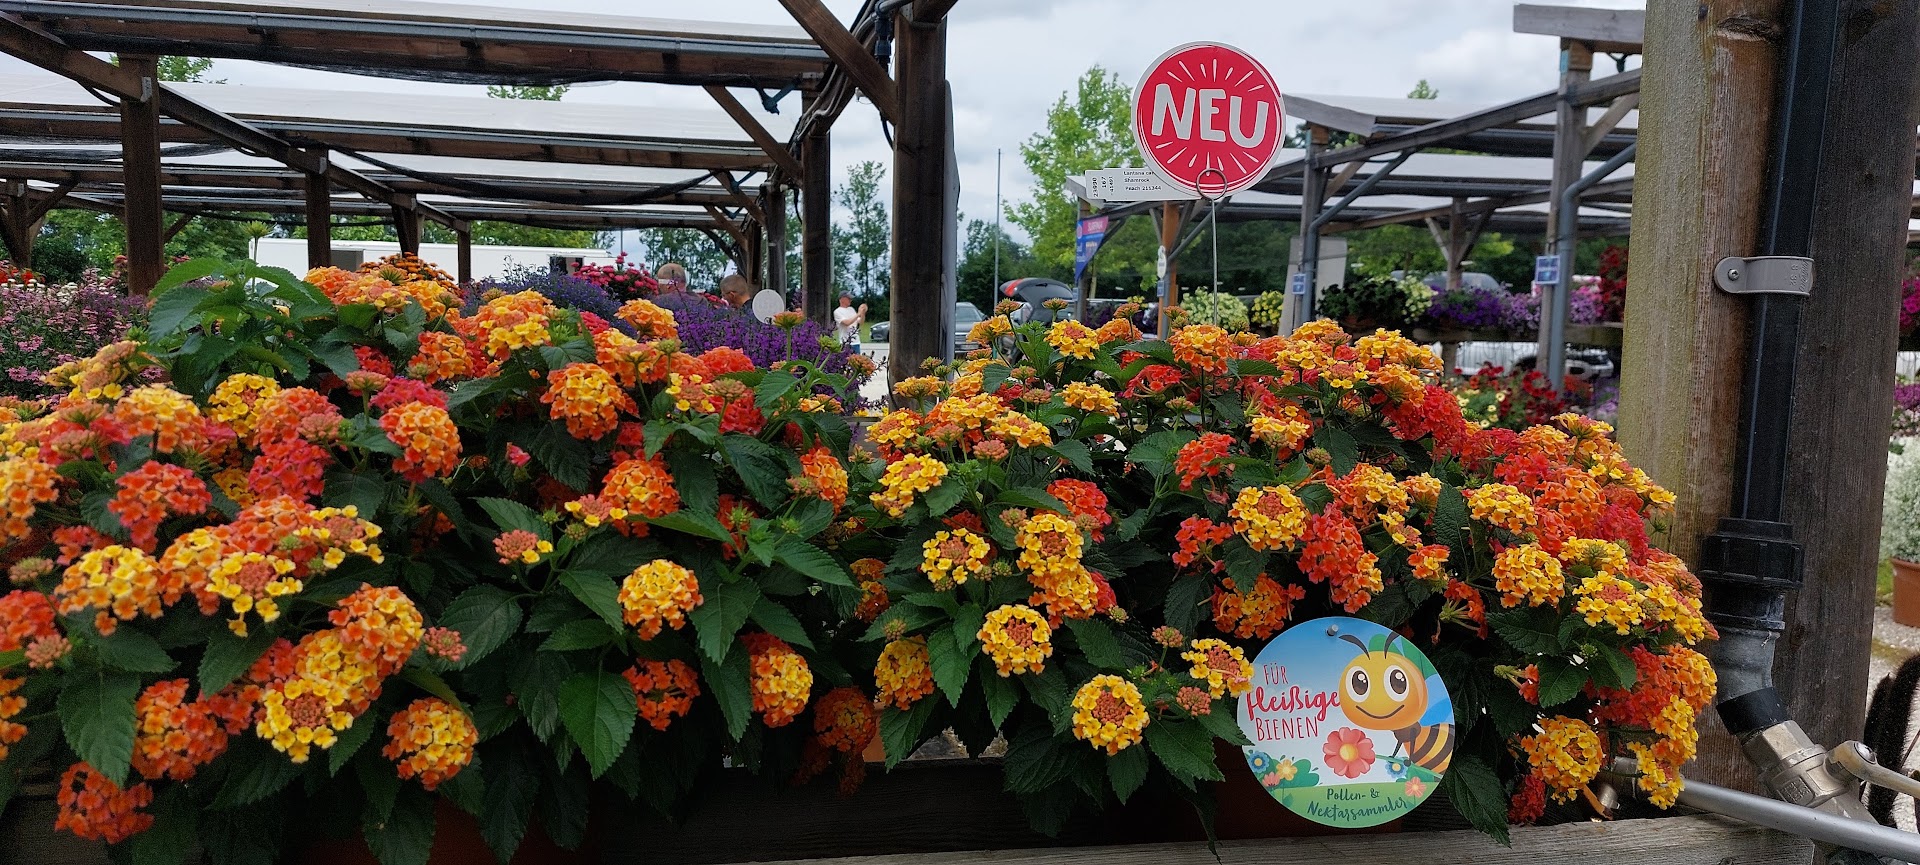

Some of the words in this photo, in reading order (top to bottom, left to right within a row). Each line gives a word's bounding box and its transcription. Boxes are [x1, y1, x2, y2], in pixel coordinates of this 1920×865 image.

[1151, 83, 1269, 149] NEU
[1263, 662, 1289, 685] FÜR
[1246, 685, 1340, 722] fleißige
[1255, 716, 1319, 742] BIENEN
[1326, 788, 1366, 800] Pollen-
[1370, 788, 1380, 799] &
[1307, 795, 1408, 822] Nektarsammler
